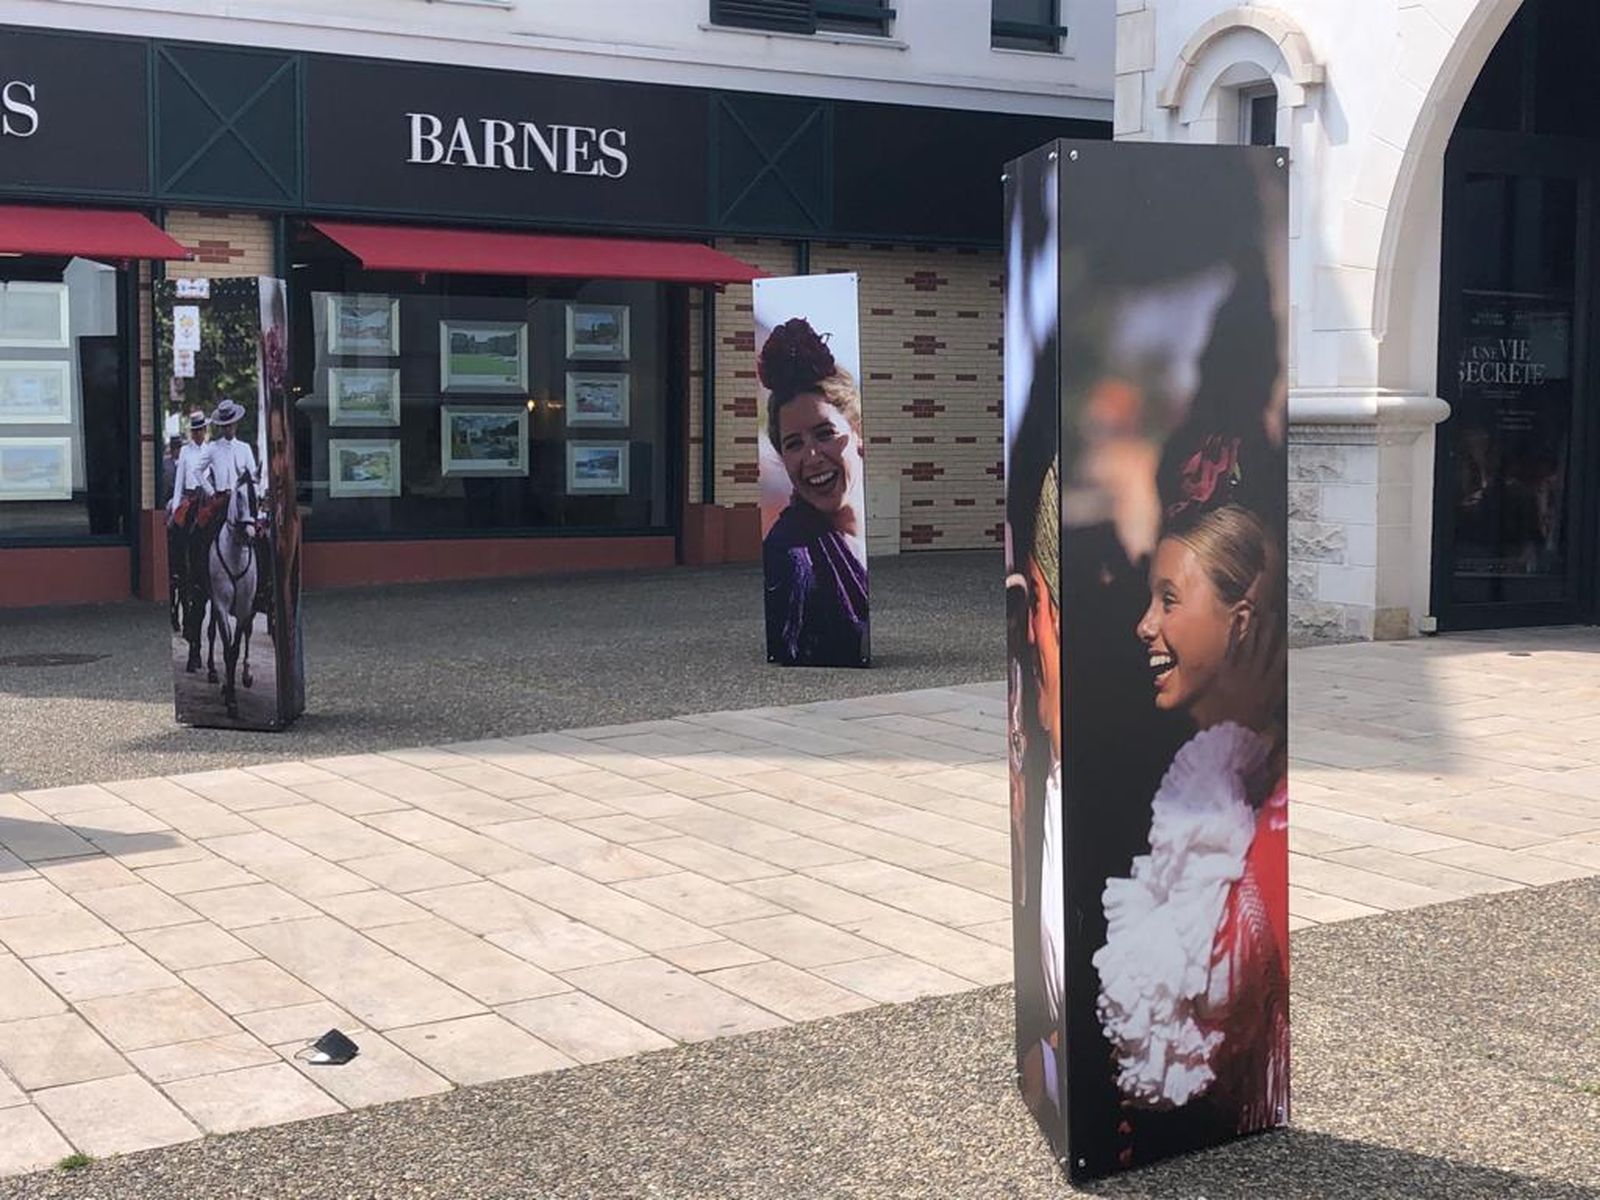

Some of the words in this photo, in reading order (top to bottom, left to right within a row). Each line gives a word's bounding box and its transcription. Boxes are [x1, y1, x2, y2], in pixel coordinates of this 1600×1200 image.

[2, 80, 39, 137] S
[405, 112, 629, 179] BARNES
[1499, 338, 1531, 361] VIE
